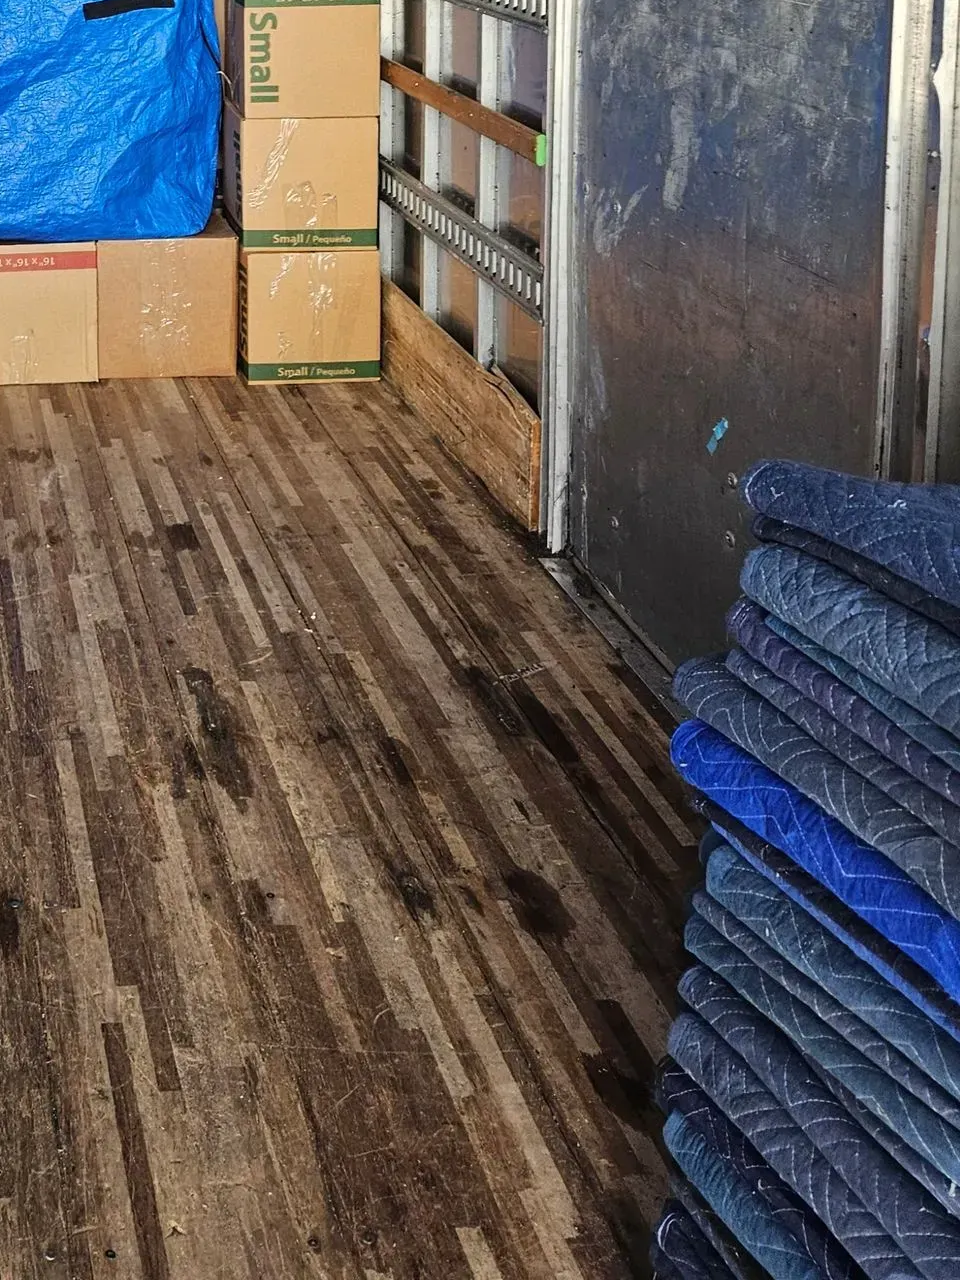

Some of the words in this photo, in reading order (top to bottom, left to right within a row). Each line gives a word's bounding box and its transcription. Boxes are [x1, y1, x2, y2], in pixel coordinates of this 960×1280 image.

[249, 12, 280, 103] Small
[272, 233, 304, 244] Small
[305, 233, 311, 244] /
[5, 258, 12, 266] x
[12, 257, 29, 268] 16"
[31, 257, 38, 265] x
[39, 256, 56, 267] 16"
[277, 366, 308, 377] Small
[310, 366, 315, 376] /
